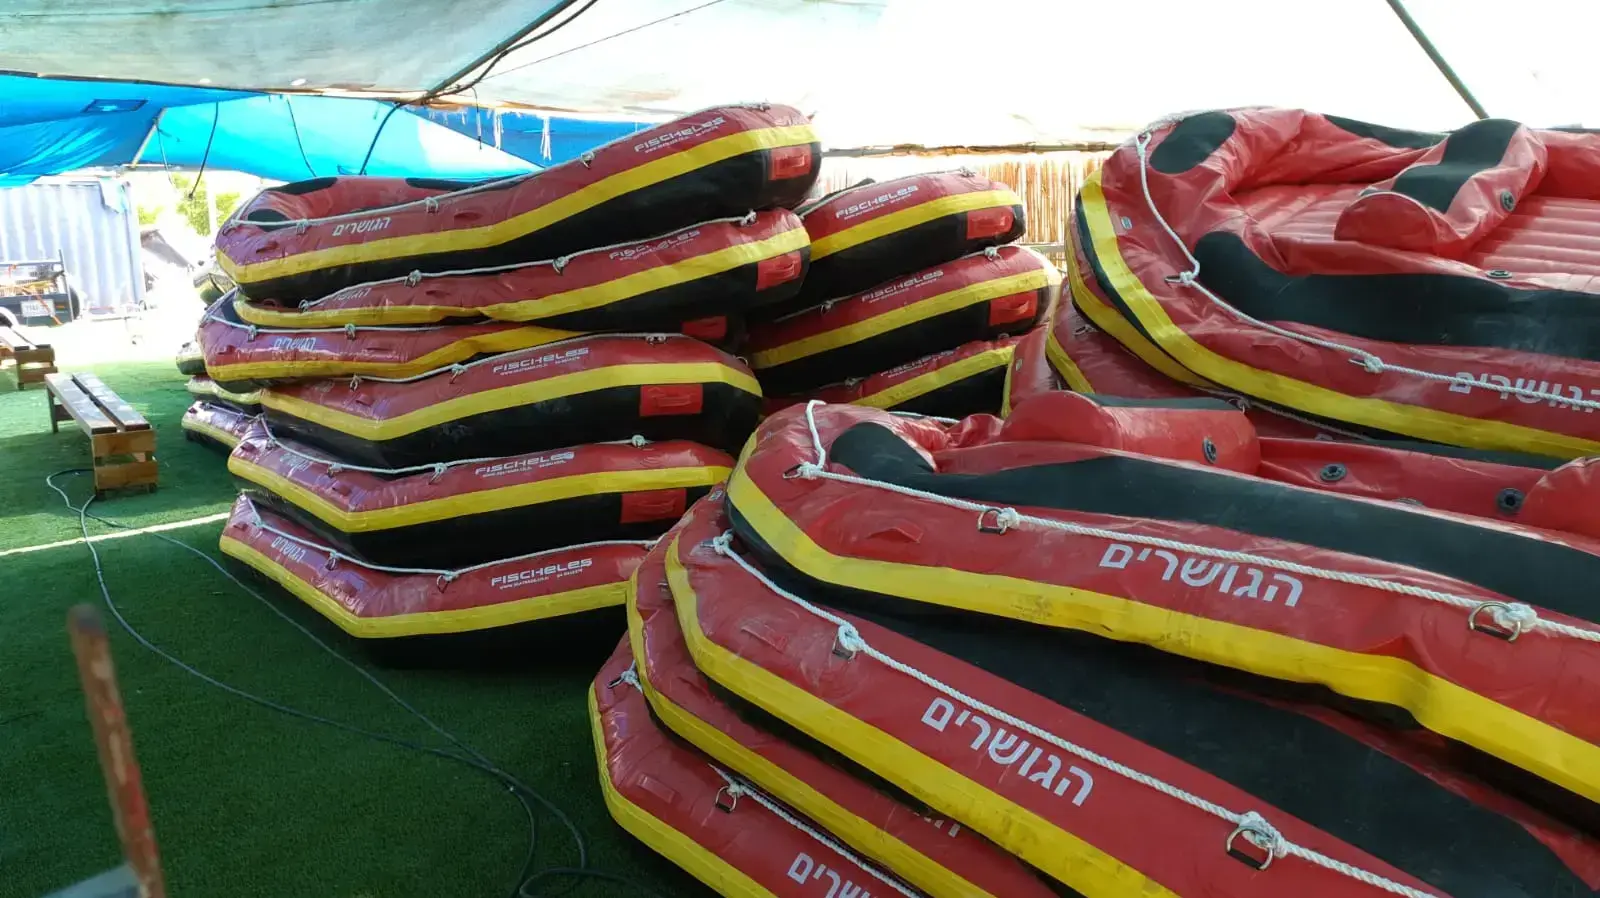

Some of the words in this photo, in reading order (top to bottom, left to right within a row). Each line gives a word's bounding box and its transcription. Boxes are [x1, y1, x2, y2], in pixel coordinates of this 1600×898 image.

[332, 217, 391, 236] הגושרים
[1099, 543, 1303, 607] הגושרים
[921, 697, 1094, 807] הגושרים
